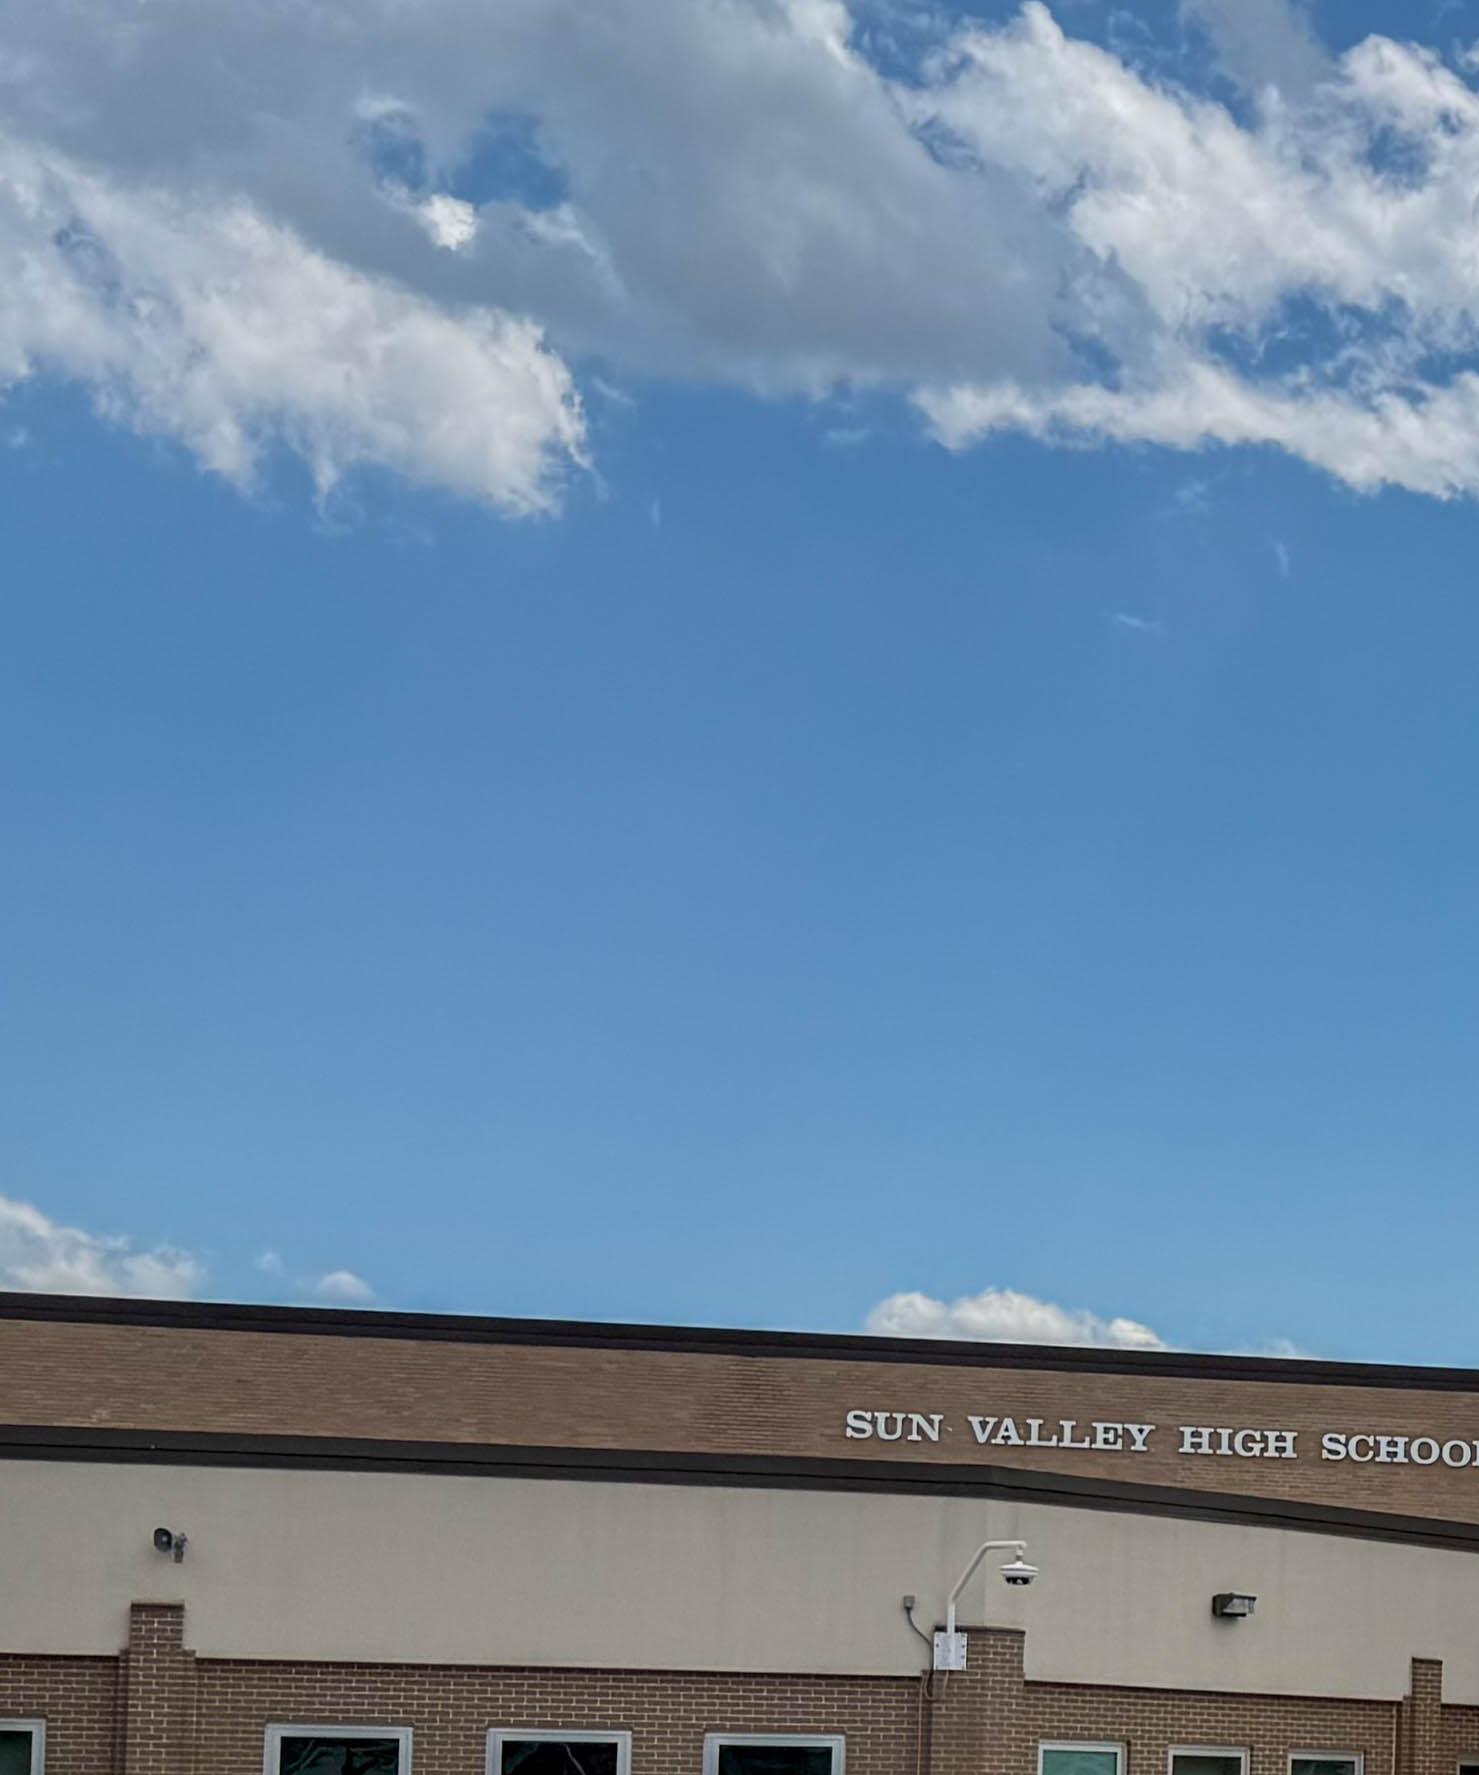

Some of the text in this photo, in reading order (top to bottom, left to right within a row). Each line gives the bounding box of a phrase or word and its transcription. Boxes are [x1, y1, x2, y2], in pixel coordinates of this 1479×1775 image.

[846, 1410, 944, 1442] SUN
[967, 1415, 1156, 1452] VALLEY
[1178, 1426, 1299, 1459] HIGH
